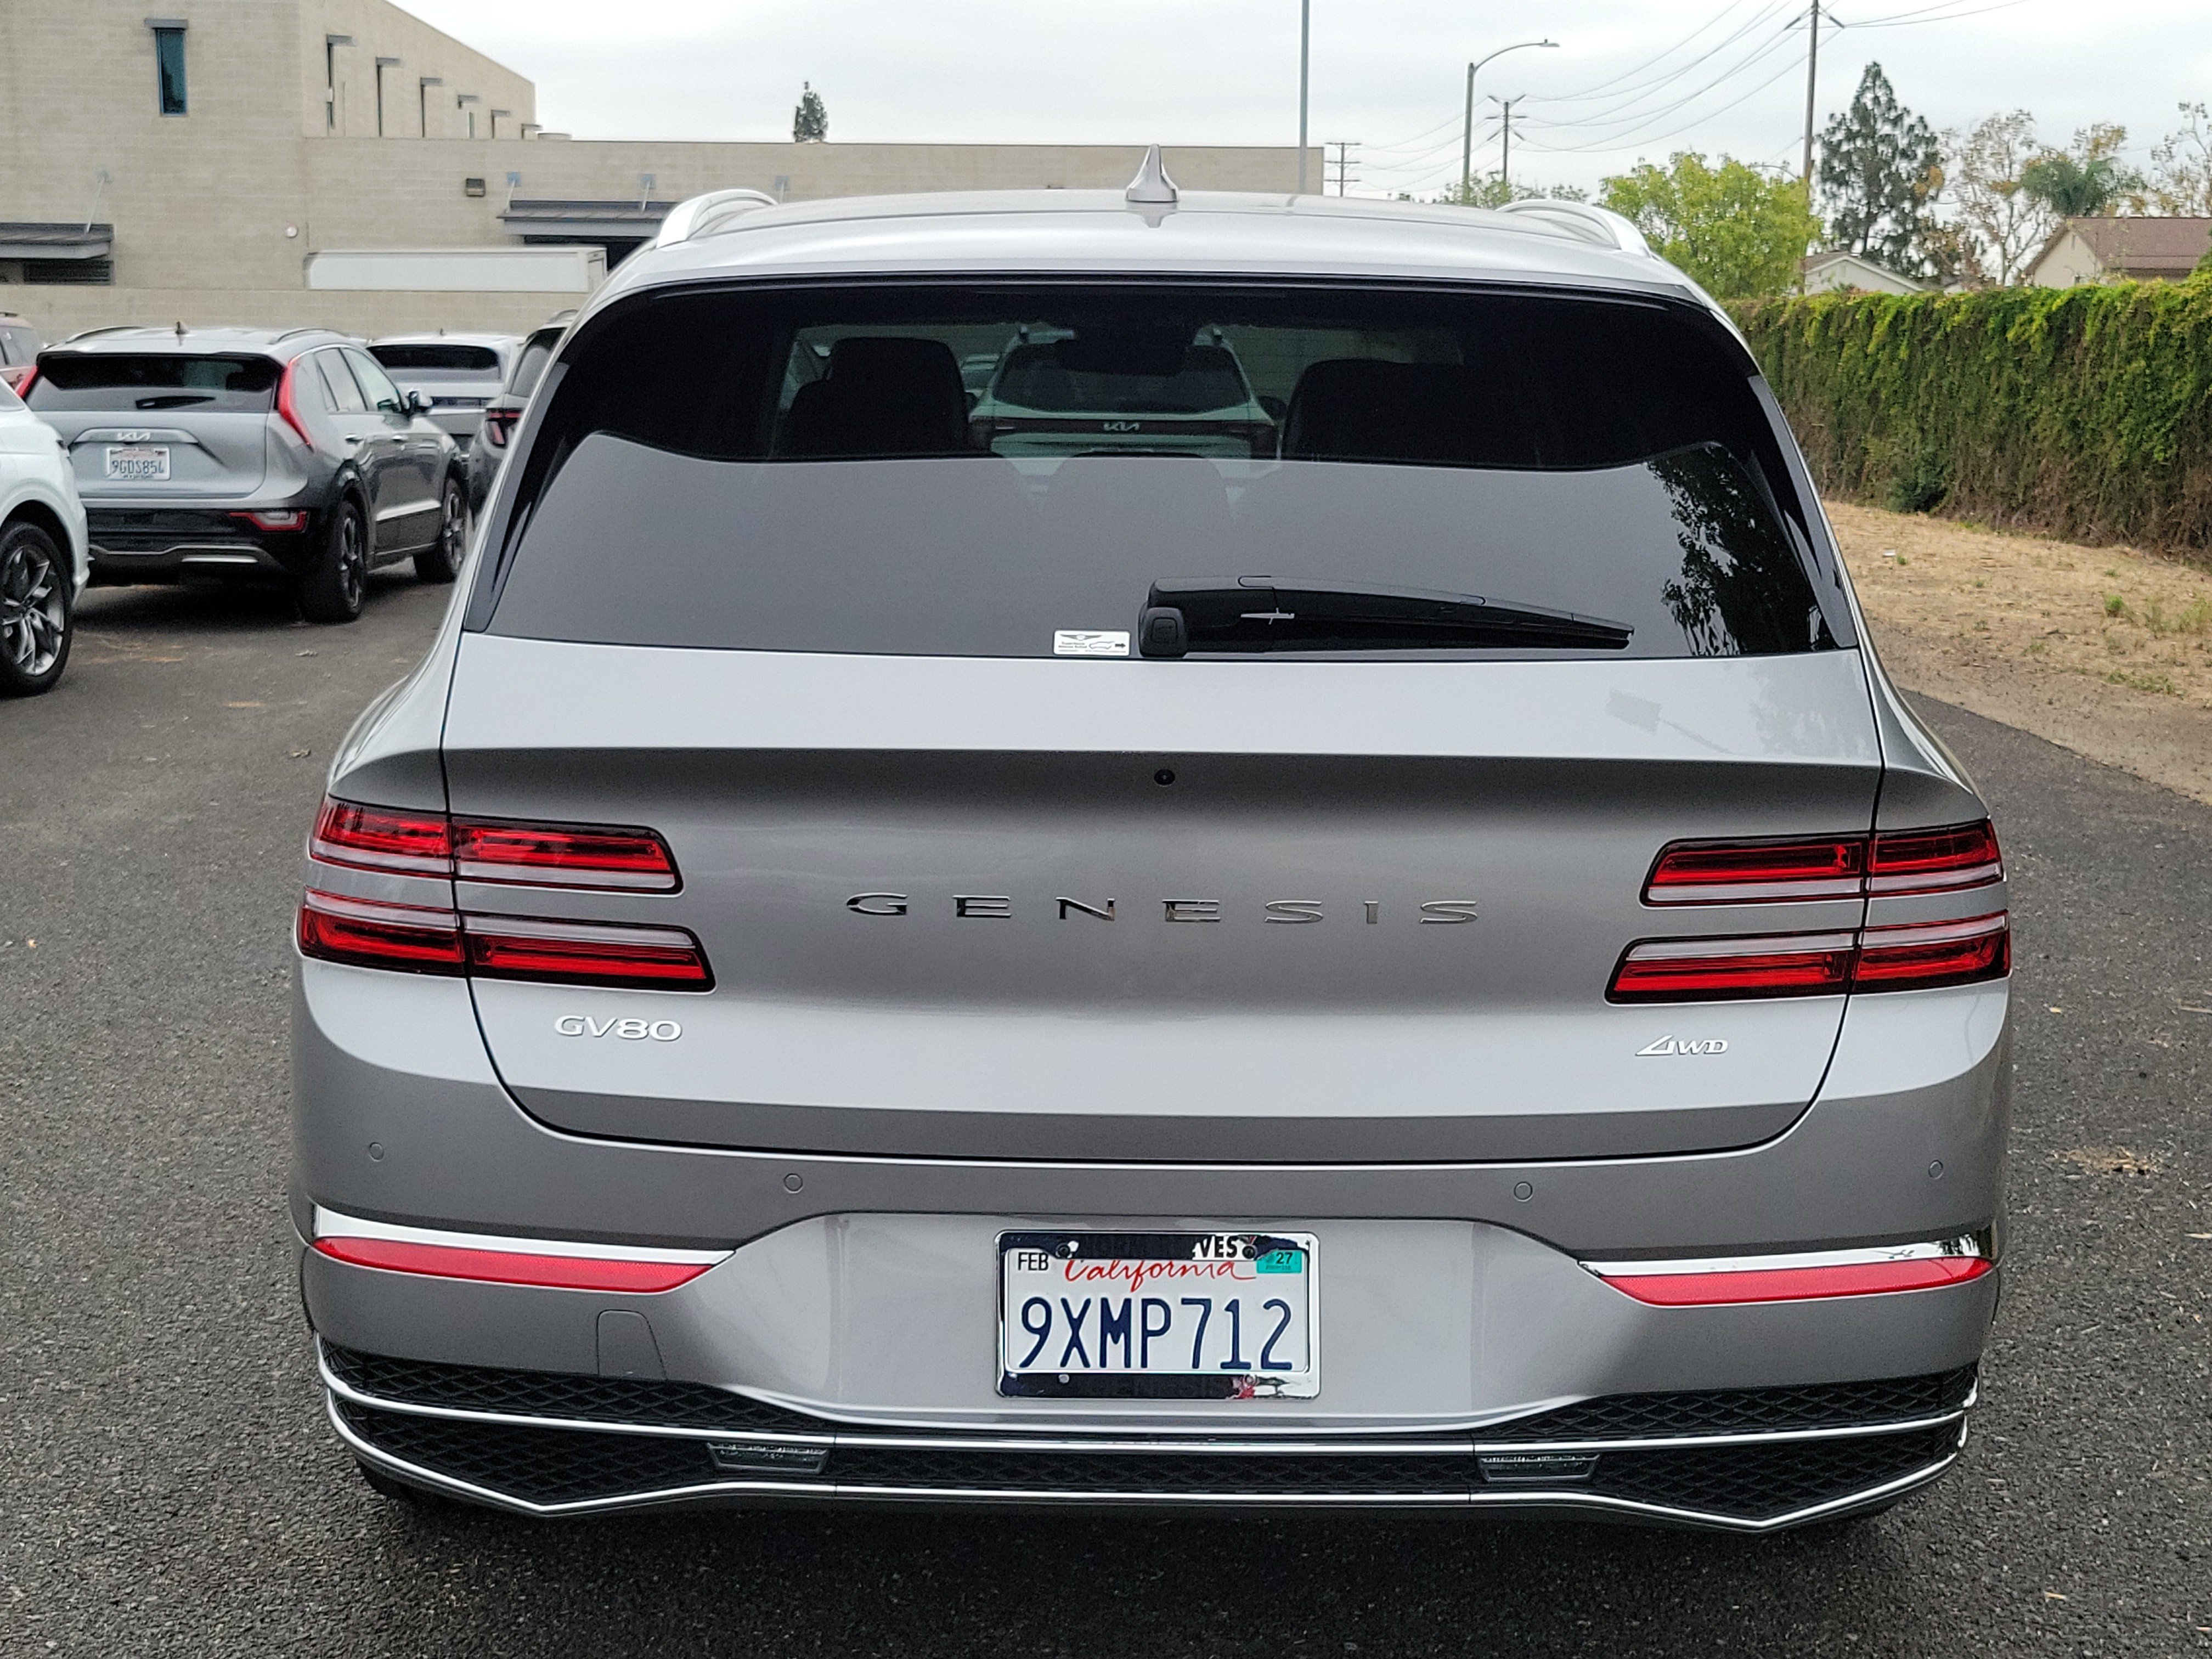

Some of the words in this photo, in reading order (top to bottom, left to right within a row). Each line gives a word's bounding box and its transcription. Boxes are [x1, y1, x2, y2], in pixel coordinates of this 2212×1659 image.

[846, 891, 1478, 924] GENESIS
[554, 1014, 683, 1042] GV80
[1018, 1252, 1049, 1271] FEB
[1276, 1251, 1293, 1265] 27
[1065, 1259, 1257, 1293] California
[1019, 1296, 1293, 1370] 9XMP712
